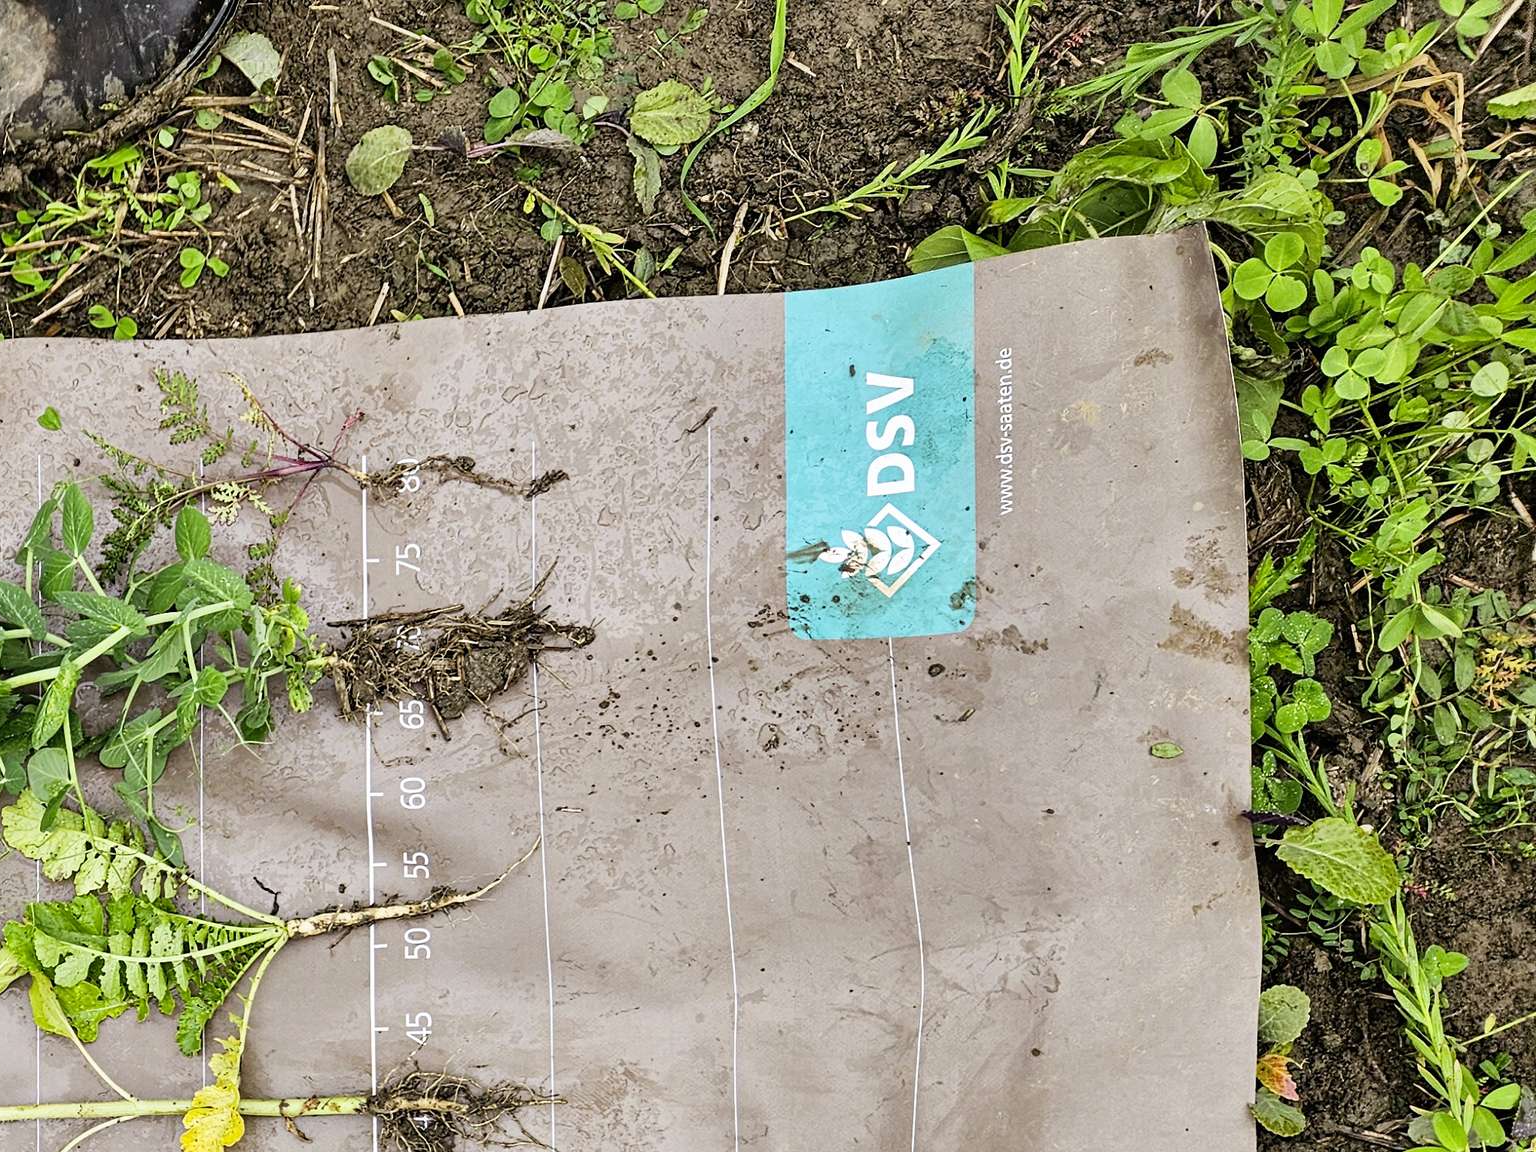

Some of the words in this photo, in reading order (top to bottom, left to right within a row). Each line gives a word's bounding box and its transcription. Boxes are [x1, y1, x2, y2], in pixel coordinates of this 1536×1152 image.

[866, 372, 915, 497] DSV
[994, 347, 1013, 516] www.dsv-saaten.de
[395, 543, 421, 575] 75
[399, 700, 425, 730] 65
[399, 777, 426, 810] 60
[403, 852, 430, 880] 55
[404, 927, 431, 959] 50
[405, 1012, 432, 1045] 45
